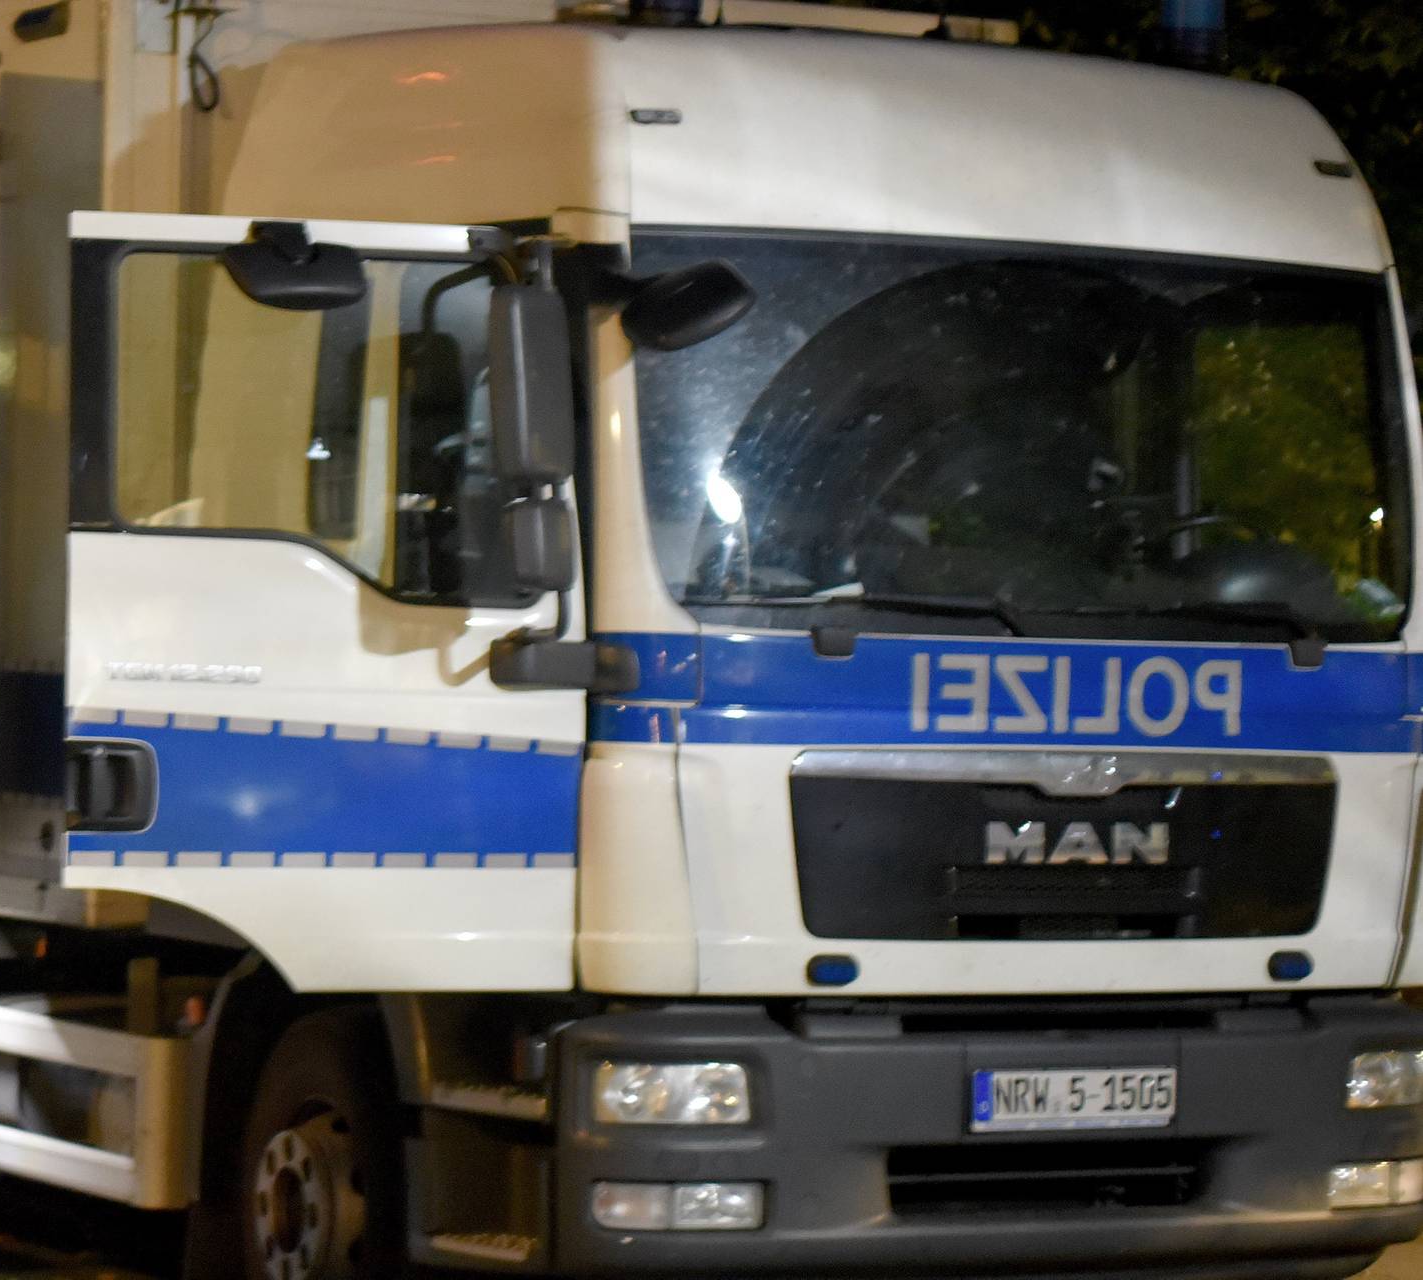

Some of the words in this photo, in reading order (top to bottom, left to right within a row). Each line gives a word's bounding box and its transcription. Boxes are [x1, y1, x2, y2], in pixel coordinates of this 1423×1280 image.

[985, 821, 1170, 865] MAN
[995, 1077, 1050, 1113] NRW
[1069, 1074, 1172, 1112] 5-1505
